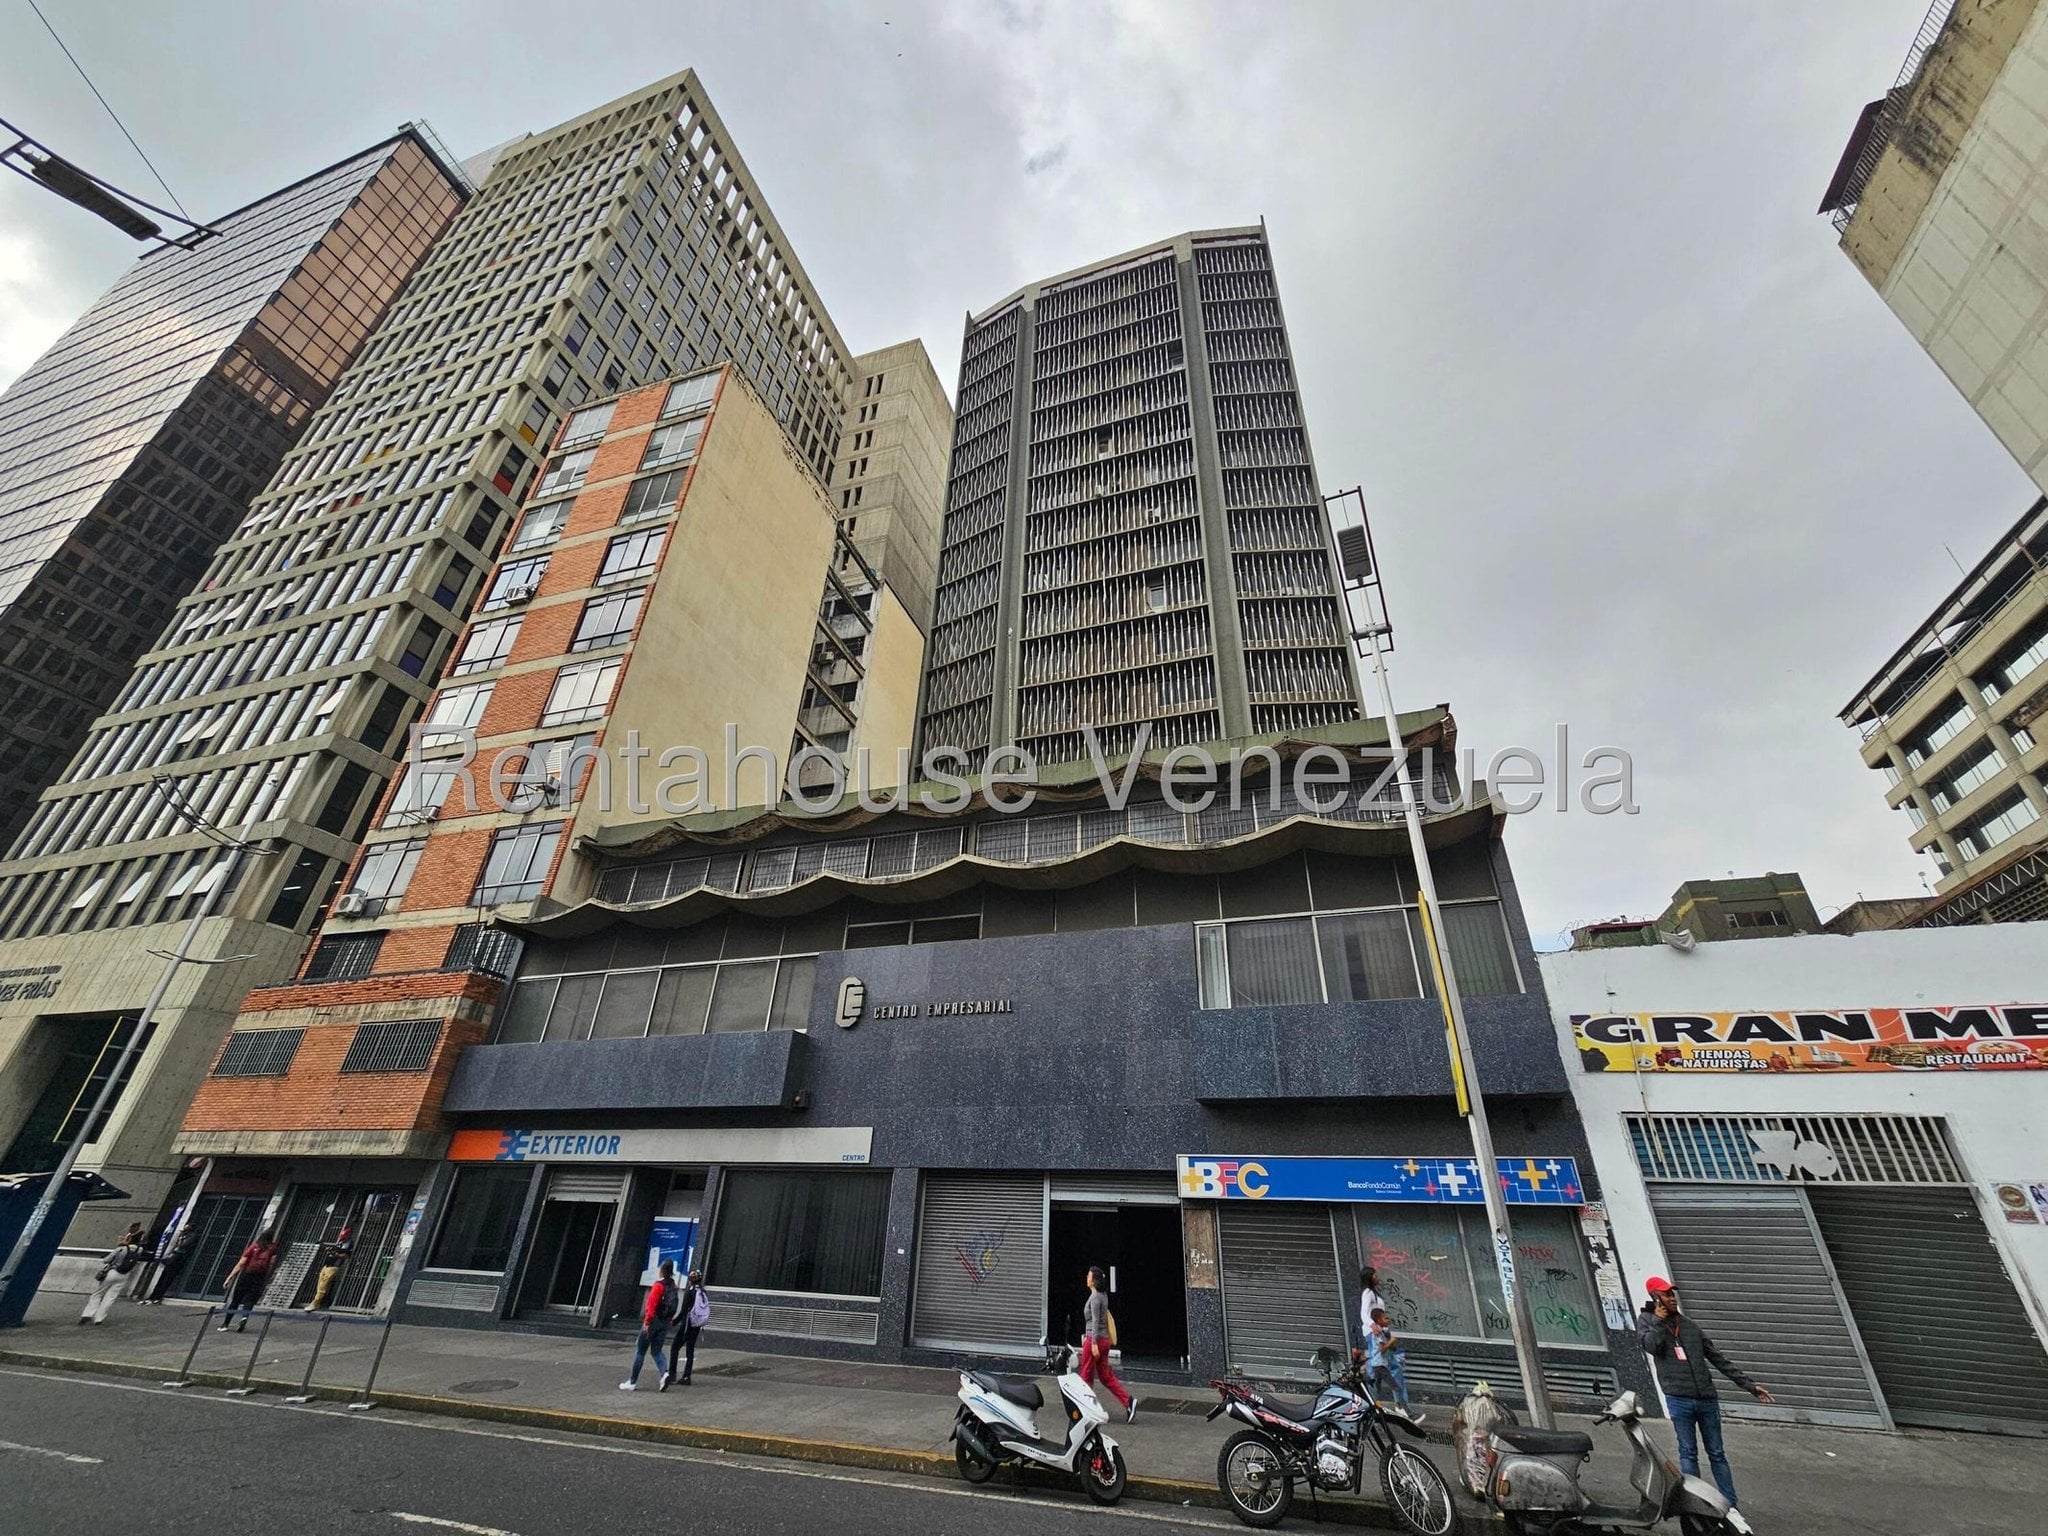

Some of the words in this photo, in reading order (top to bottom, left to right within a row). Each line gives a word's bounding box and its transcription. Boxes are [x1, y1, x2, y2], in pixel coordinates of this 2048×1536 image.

[17, 976, 61, 1000] FRÍAS
[874, 1004, 918, 1019] CENTRO
[926, 1000, 1013, 1018] EMPRESARIAL
[1584, 1013, 1876, 1044] GRAN
[1682, 1058, 1768, 1069] NATURISTAS
[1692, 1049, 1751, 1060] TIENDAS
[1926, 1052, 2029, 1066] RESTAURANT
[529, 1135, 621, 1155] EXTERIOR
[1194, 1161, 1270, 1199] BFC
